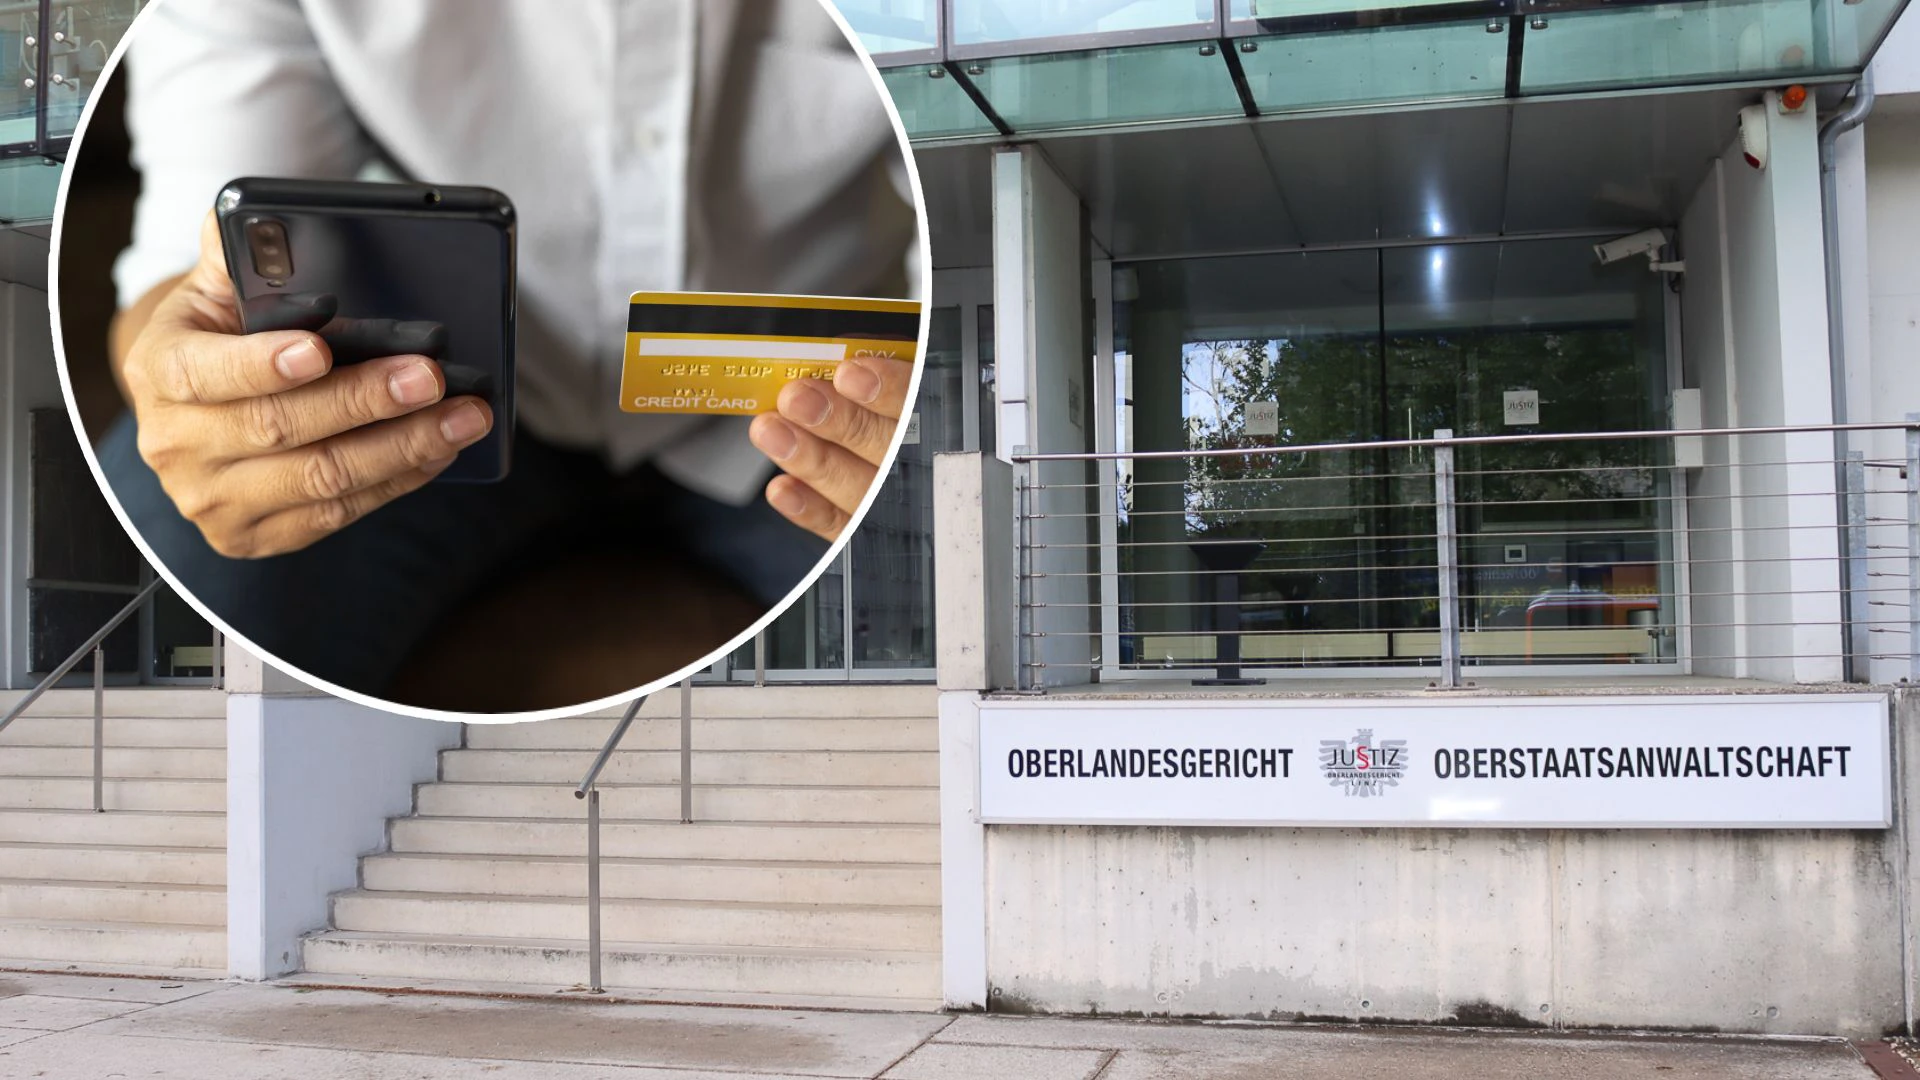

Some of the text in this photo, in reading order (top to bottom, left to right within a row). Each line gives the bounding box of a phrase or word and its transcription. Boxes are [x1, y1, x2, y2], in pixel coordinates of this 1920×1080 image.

[634, 396, 758, 410] CREDIT CARD
[1008, 748, 1294, 778] OBERLANDESGERICHT
[1434, 746, 1852, 779] OBERSTAATSANWALTSCHAFT
[1327, 771, 1400, 779] OBERLANDESGERICHT
